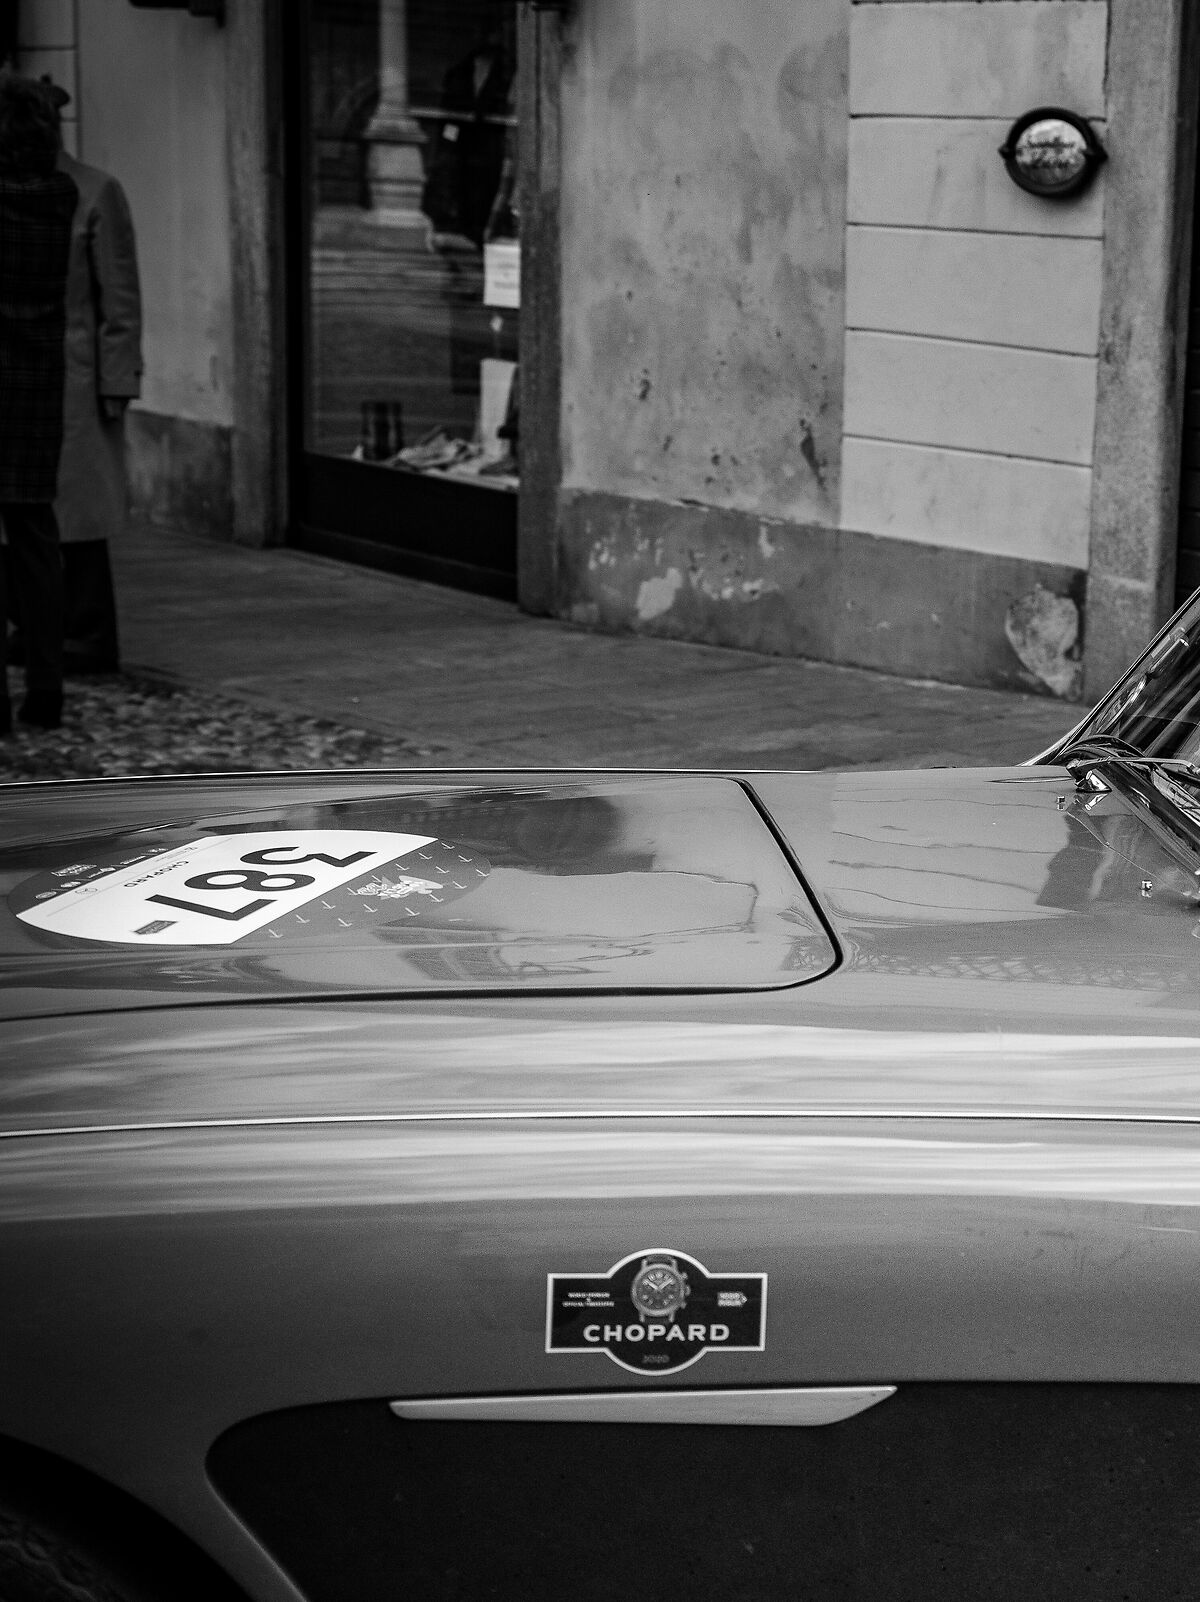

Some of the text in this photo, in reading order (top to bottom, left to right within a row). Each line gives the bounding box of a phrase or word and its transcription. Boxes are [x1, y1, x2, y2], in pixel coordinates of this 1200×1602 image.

[124, 861, 189, 888] CHOPARD
[145, 846, 378, 921] 387
[583, 1323, 730, 1343] CHOPARD
